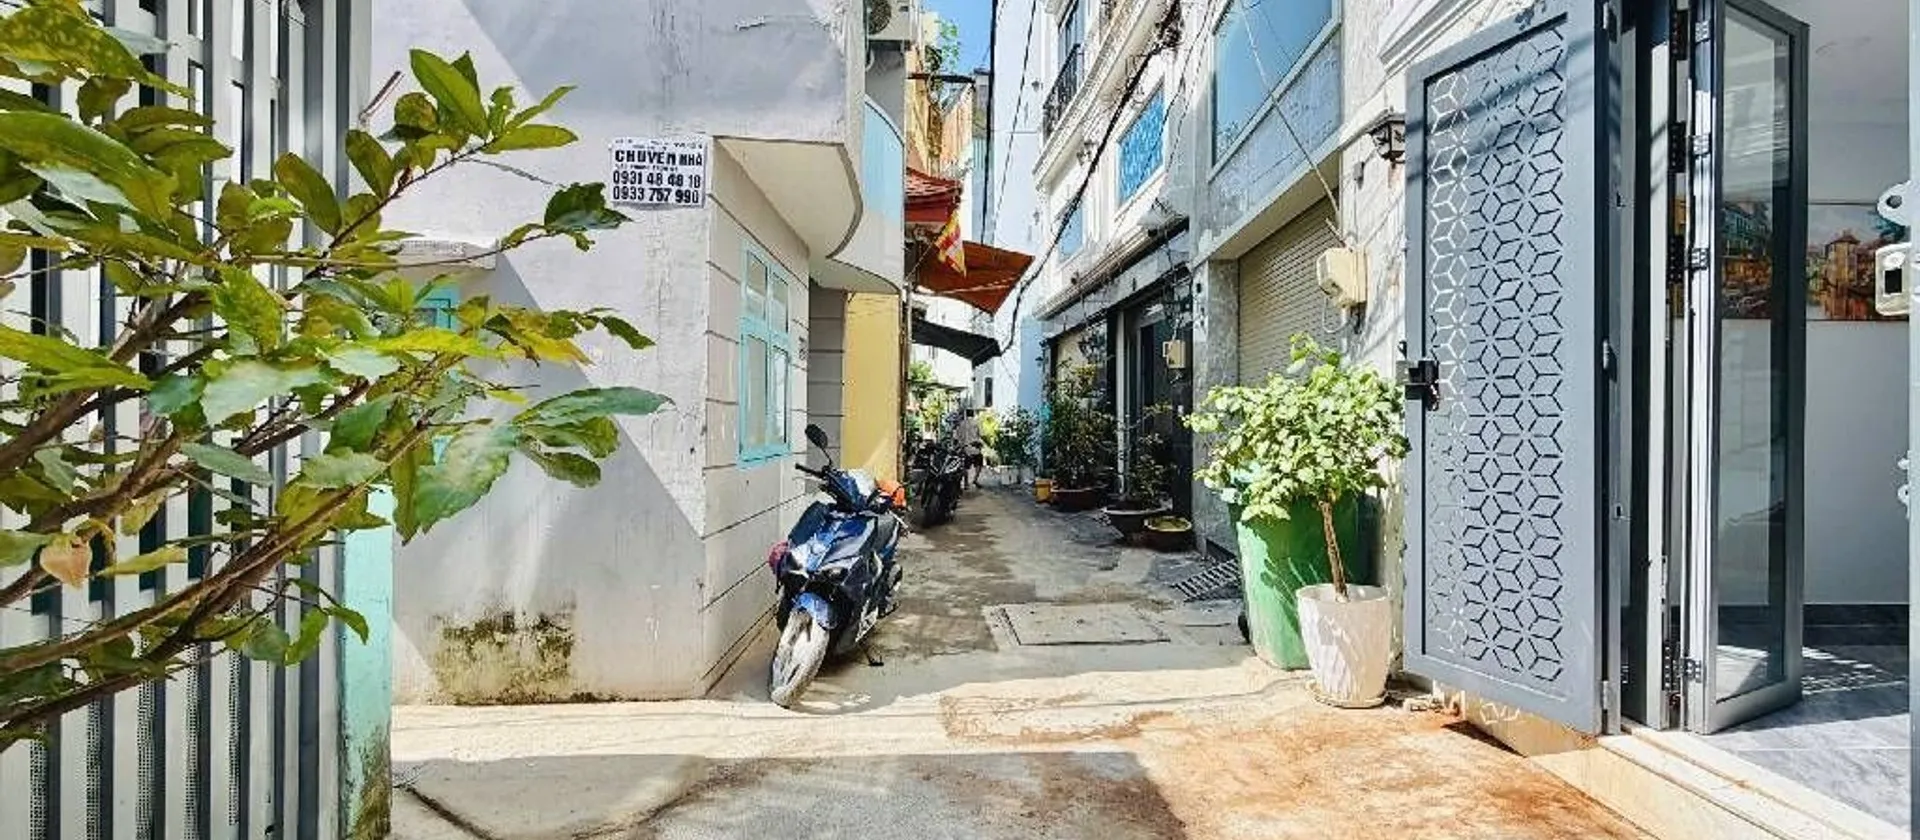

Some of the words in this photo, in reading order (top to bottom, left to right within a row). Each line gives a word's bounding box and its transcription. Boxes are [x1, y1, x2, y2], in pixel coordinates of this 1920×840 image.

[613, 170, 642, 185] 0931
[646, 172, 663, 186] 48
[667, 173, 684, 187] 48
[613, 185, 644, 200] 0933
[648, 187, 673, 202] 757
[675, 189, 699, 204] 990
